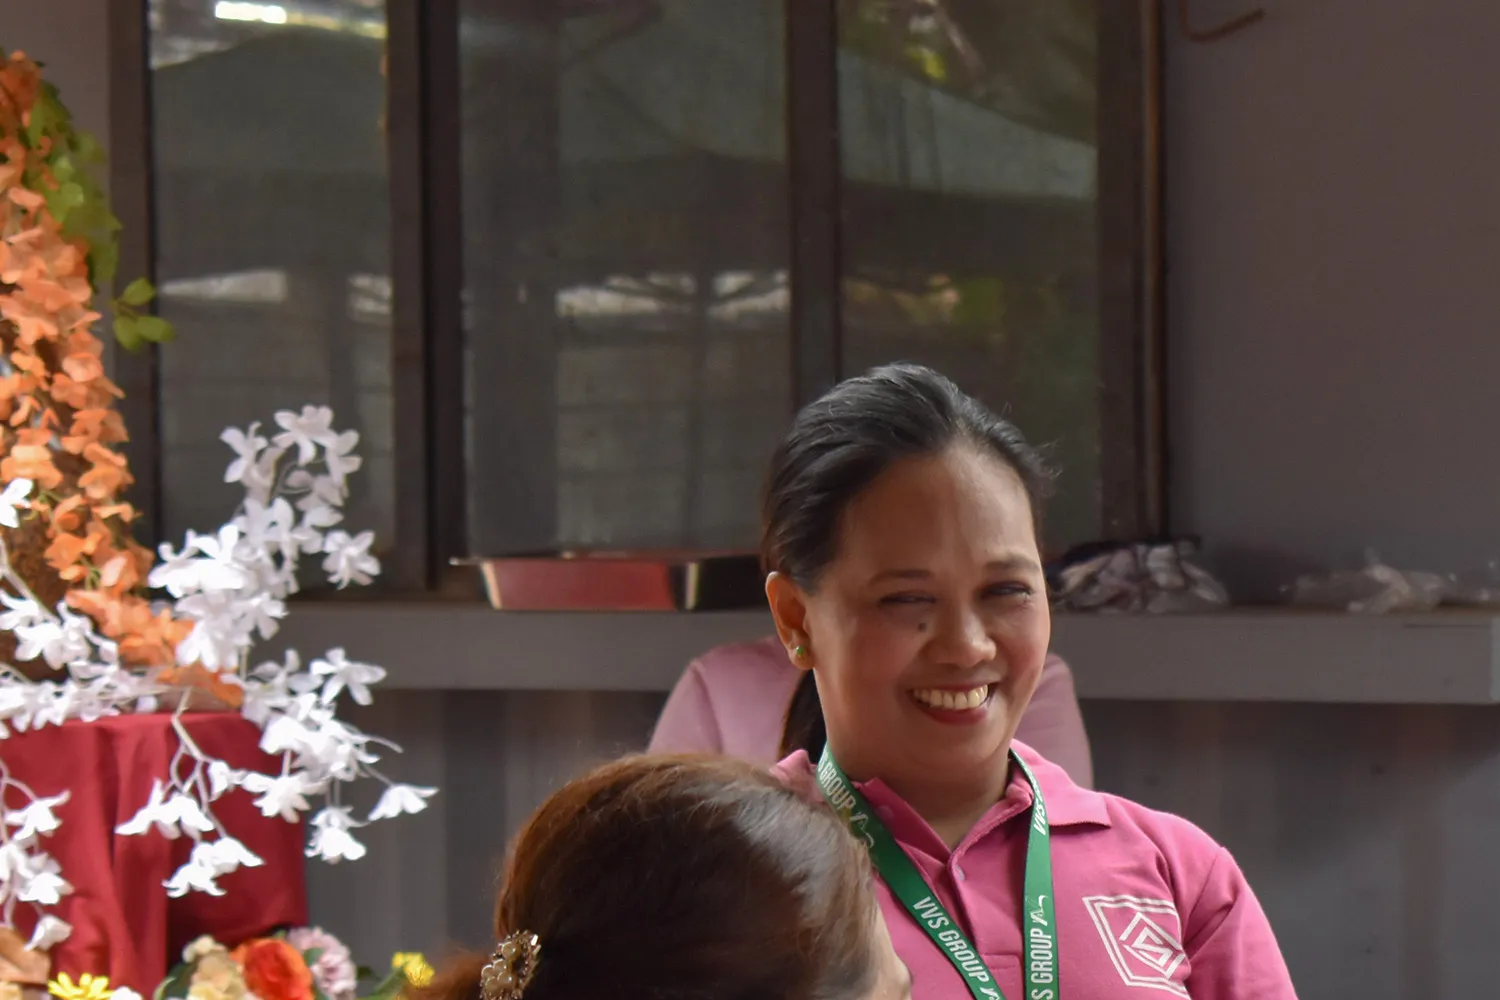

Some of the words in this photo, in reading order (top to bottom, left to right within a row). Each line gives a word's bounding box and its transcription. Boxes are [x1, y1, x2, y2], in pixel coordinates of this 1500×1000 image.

[912, 896, 949, 930] VVS
[938, 930, 990, 983] GROUP
[1030, 927, 1054, 984] GROUP
